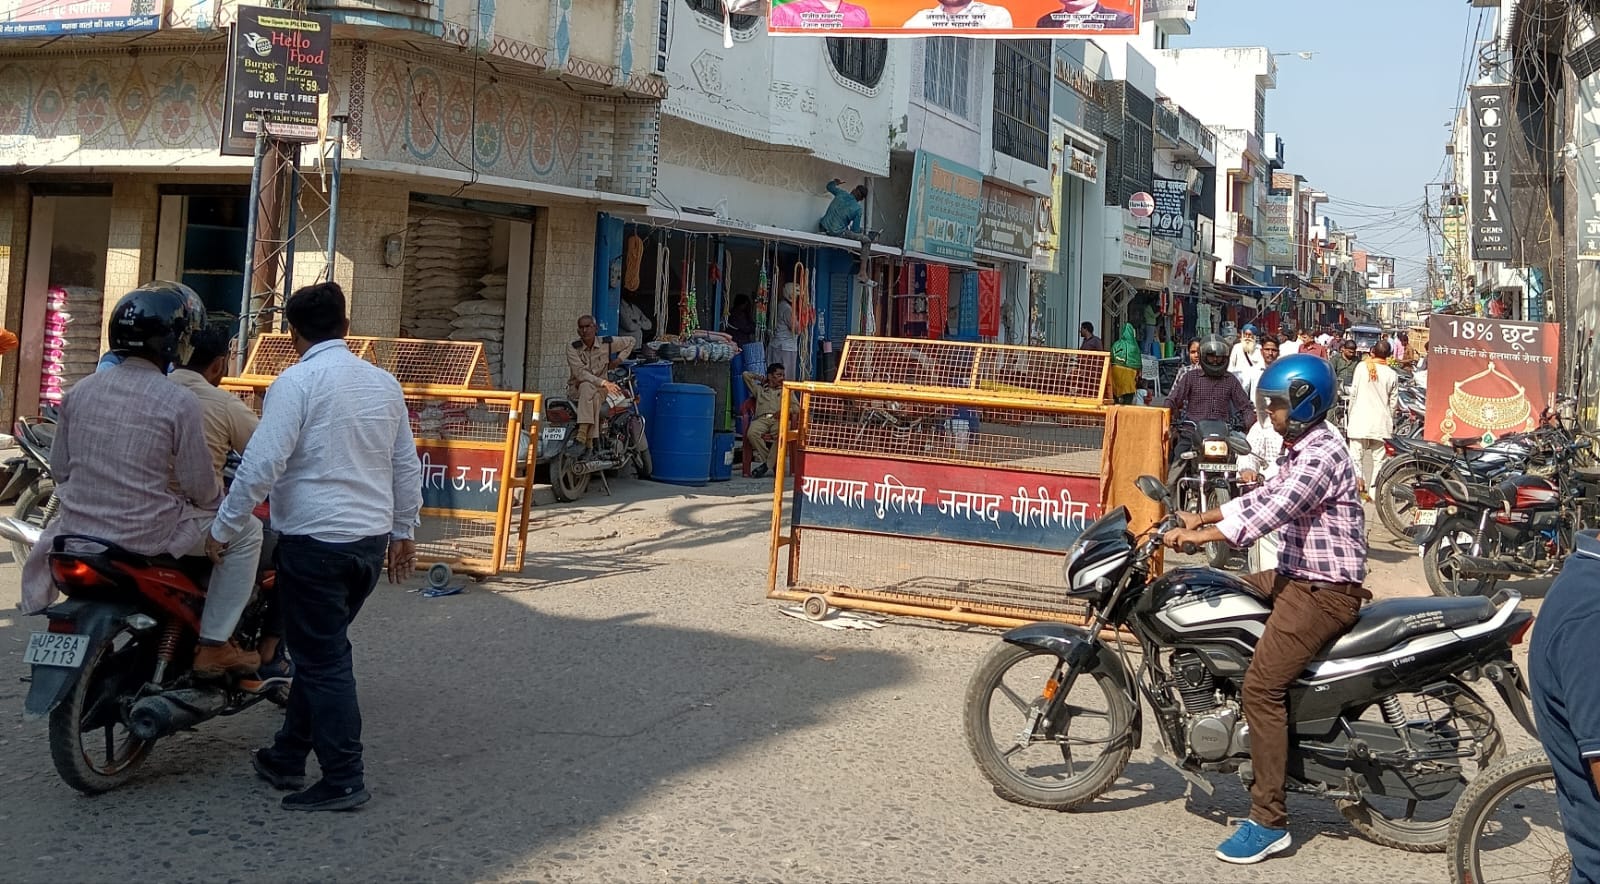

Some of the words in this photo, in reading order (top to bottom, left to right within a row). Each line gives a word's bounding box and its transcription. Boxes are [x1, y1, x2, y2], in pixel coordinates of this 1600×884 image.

[271, 31, 310, 49] Hello
[244, 58, 276, 70] Burger
[290, 48, 324, 65] Food
[287, 66, 313, 76] Pizza
[248, 90, 265, 99] BUY
[266, 91, 271, 100] 1
[273, 92, 289, 101] GET
[290, 94, 295, 102] 1
[297, 94, 318, 104] FREE
[1482, 132, 1500, 222] GEHNA
[1480, 226, 1503, 234] GEMS
[1482, 235, 1501, 243] AND
[1448, 320, 1493, 341] 18%
[1499, 324, 1539, 351] छूट
[1433, 345, 1449, 355] सोने
[1450, 347, 1457, 356] व
[1542, 356, 1552, 364] पर
[452, 466, 471, 492] उ.
[480, 467, 498, 493] प्र.
[801, 476, 869, 509] यातायात
[874, 474, 926, 519] पुलिस
[937, 489, 1004, 529] जनपद
[1011, 486, 1090, 532] पीलीभीत
[38, 634, 79, 651] UP26A
[32, 649, 76, 665] L7113
